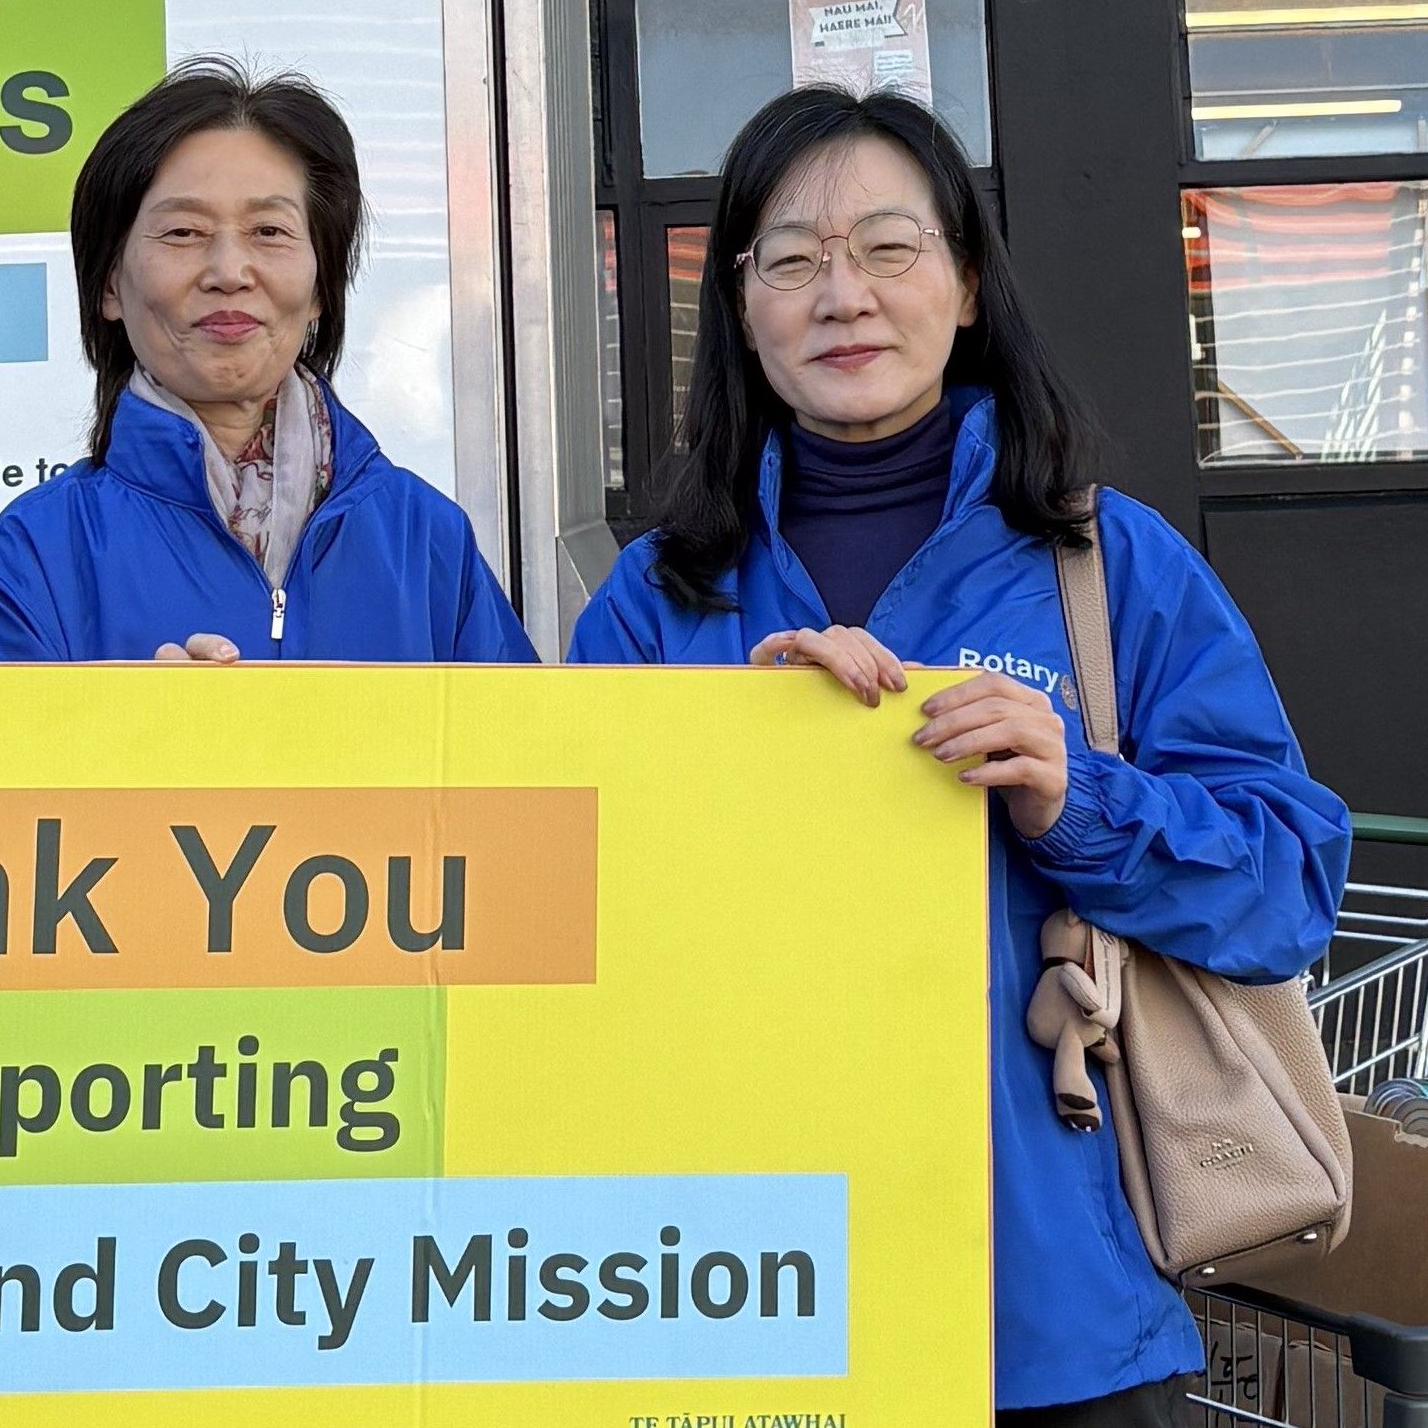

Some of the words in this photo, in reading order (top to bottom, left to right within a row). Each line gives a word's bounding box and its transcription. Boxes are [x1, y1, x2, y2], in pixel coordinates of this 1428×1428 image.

[819, 19, 861, 33] HAERE
[959, 646, 1059, 693] Rotary
[170, 825, 466, 954] You
[157, 1232, 376, 1351] City
[411, 1225, 816, 1323] Mission
